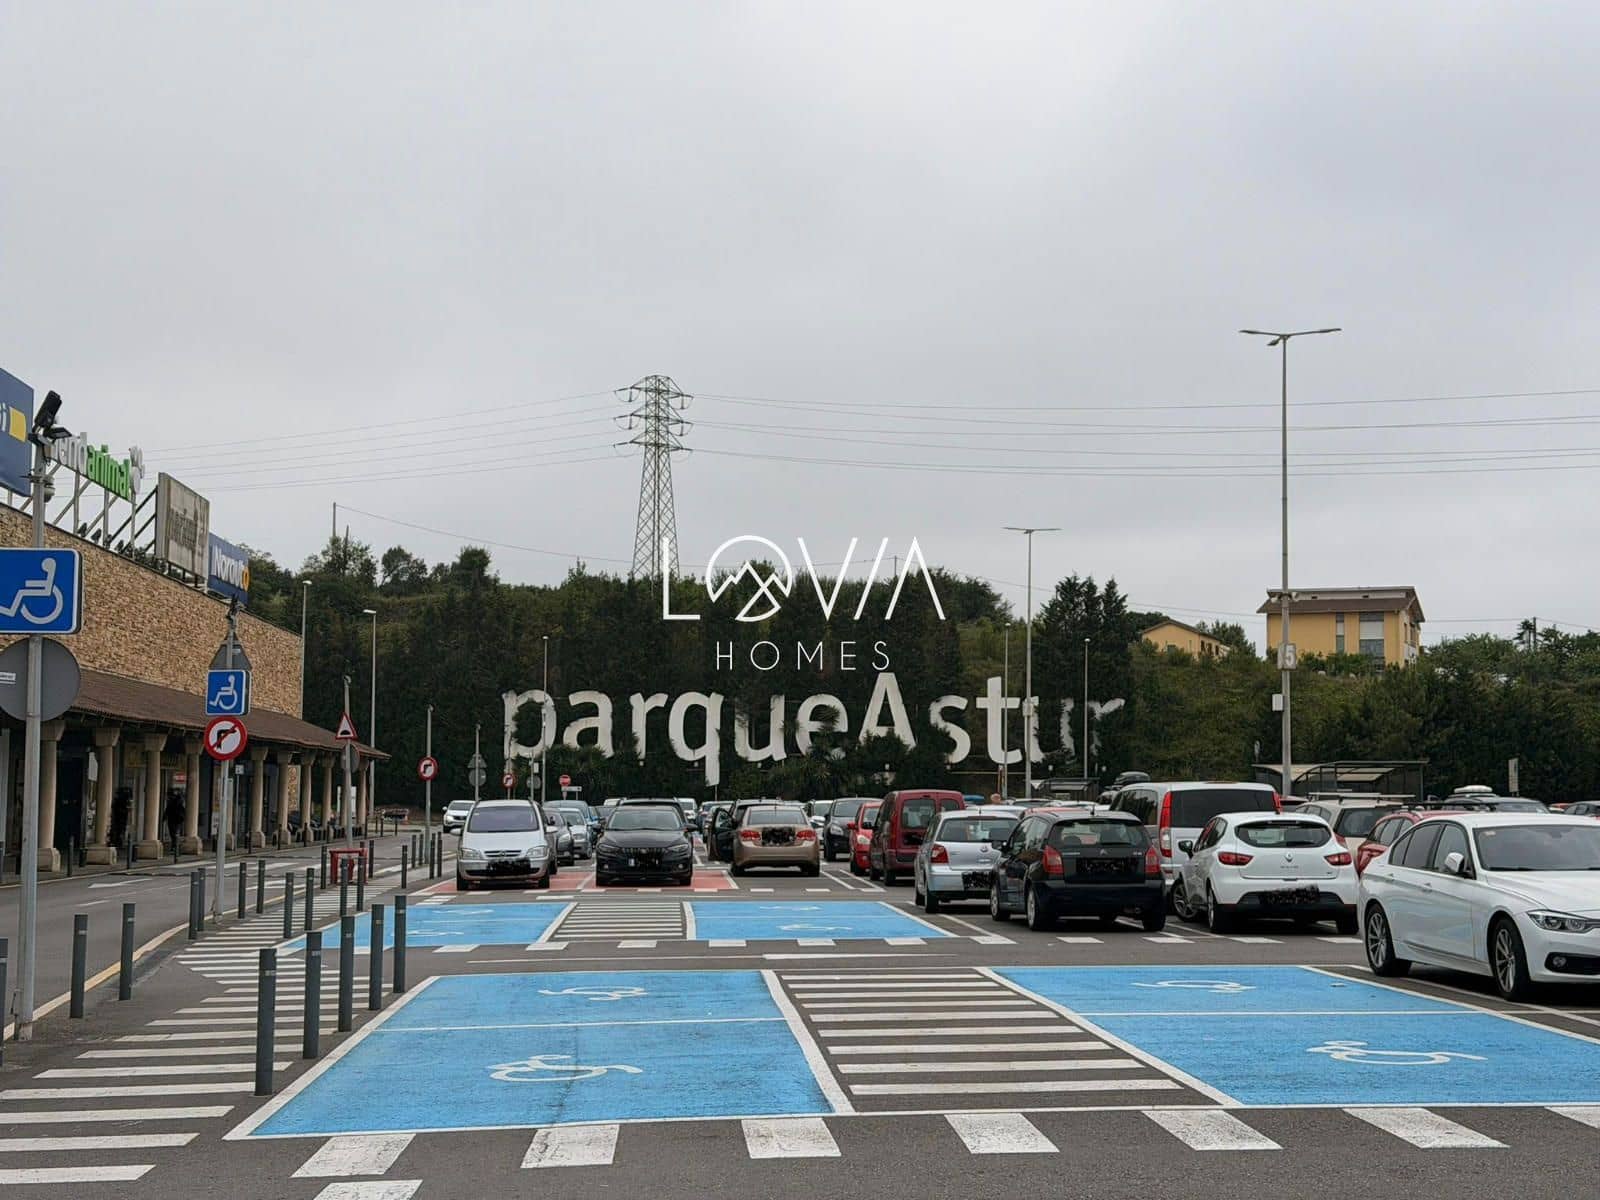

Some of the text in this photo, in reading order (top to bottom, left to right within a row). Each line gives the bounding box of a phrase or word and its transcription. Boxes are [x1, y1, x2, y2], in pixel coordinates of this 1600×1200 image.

[49, 432, 131, 501] endanimal
[211, 545, 250, 592] Norauto
[501, 671, 1126, 787] parqueAstur
